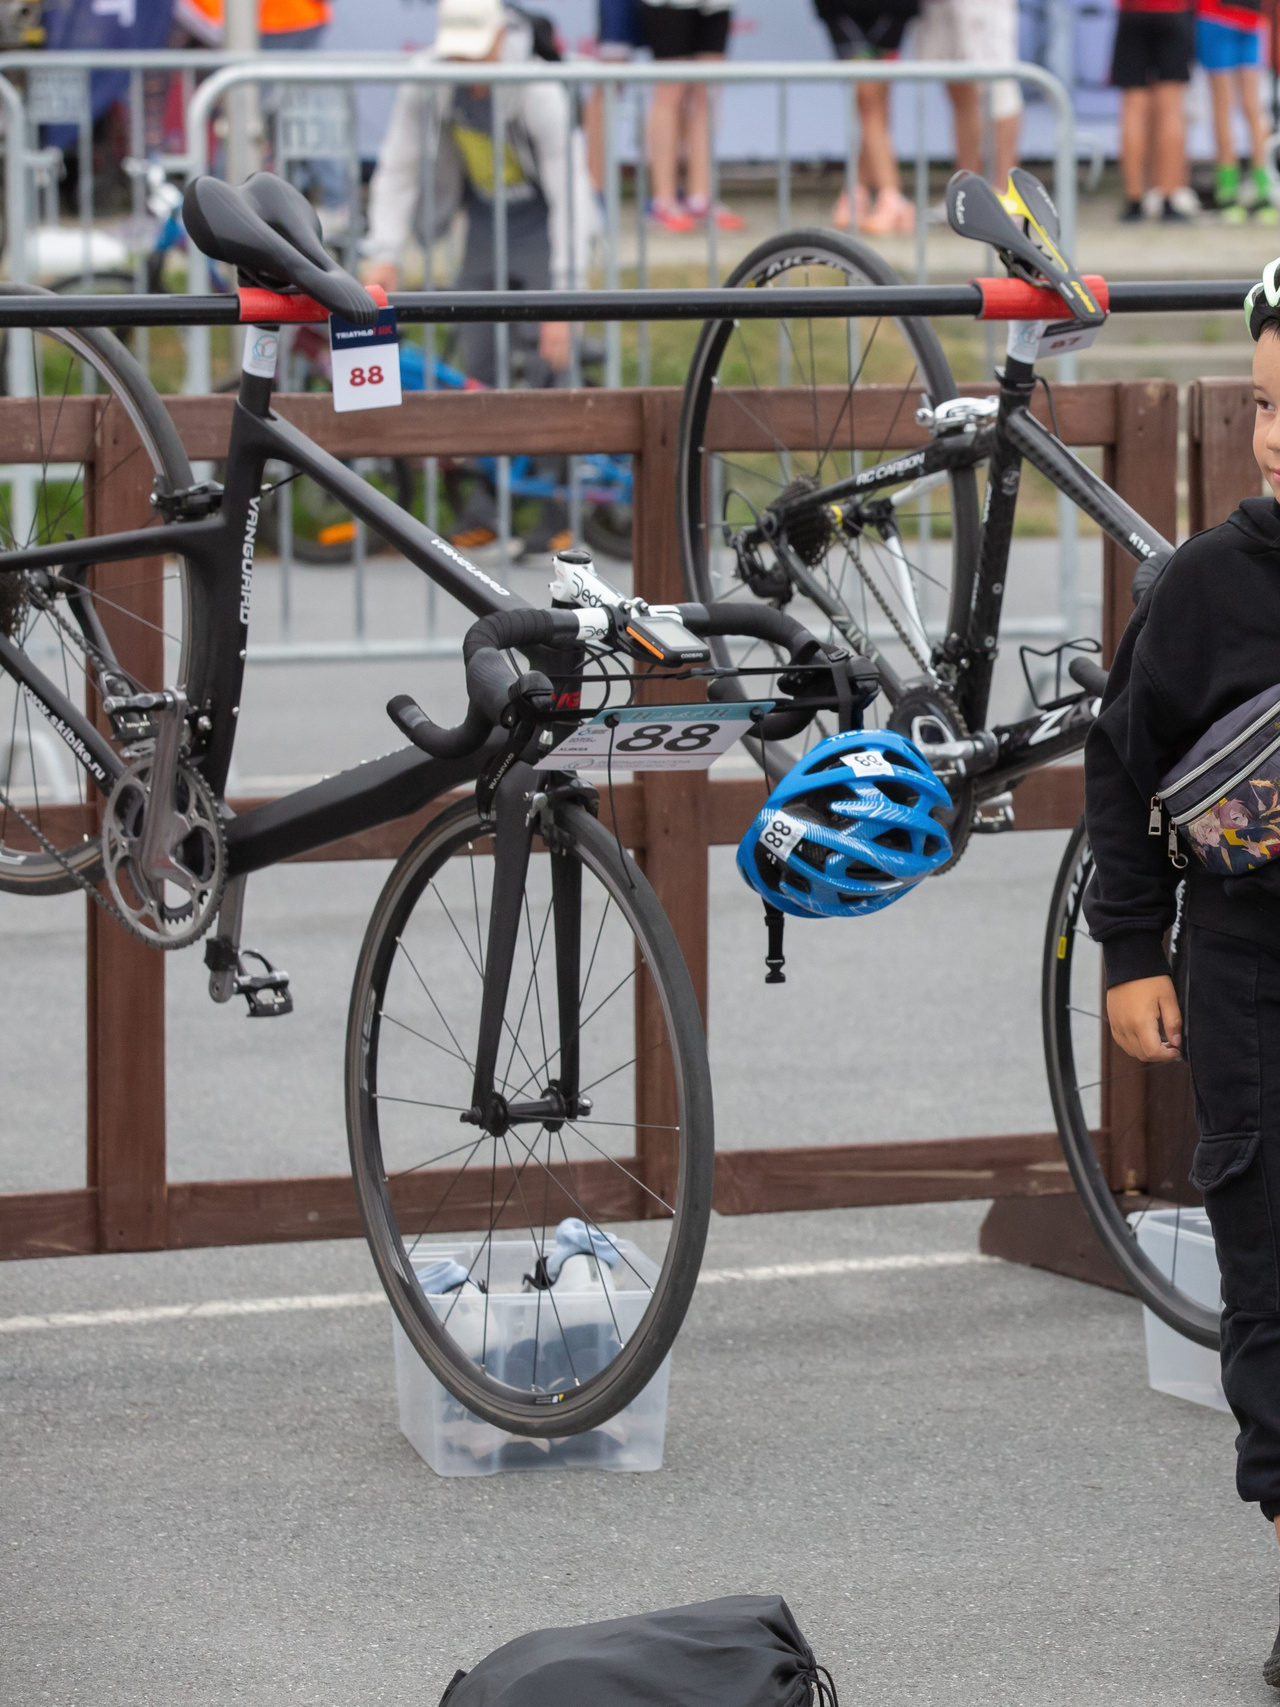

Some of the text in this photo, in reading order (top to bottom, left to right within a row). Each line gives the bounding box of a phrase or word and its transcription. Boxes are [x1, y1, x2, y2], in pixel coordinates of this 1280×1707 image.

[349, 365, 385, 387] 88
[239, 496, 262, 626] VANGUARD
[430, 538, 511, 597] VANGUARD
[20, 680, 107, 781] www.skibike.ru
[614, 723, 721, 752] 88
[764, 819, 793, 849] 88
